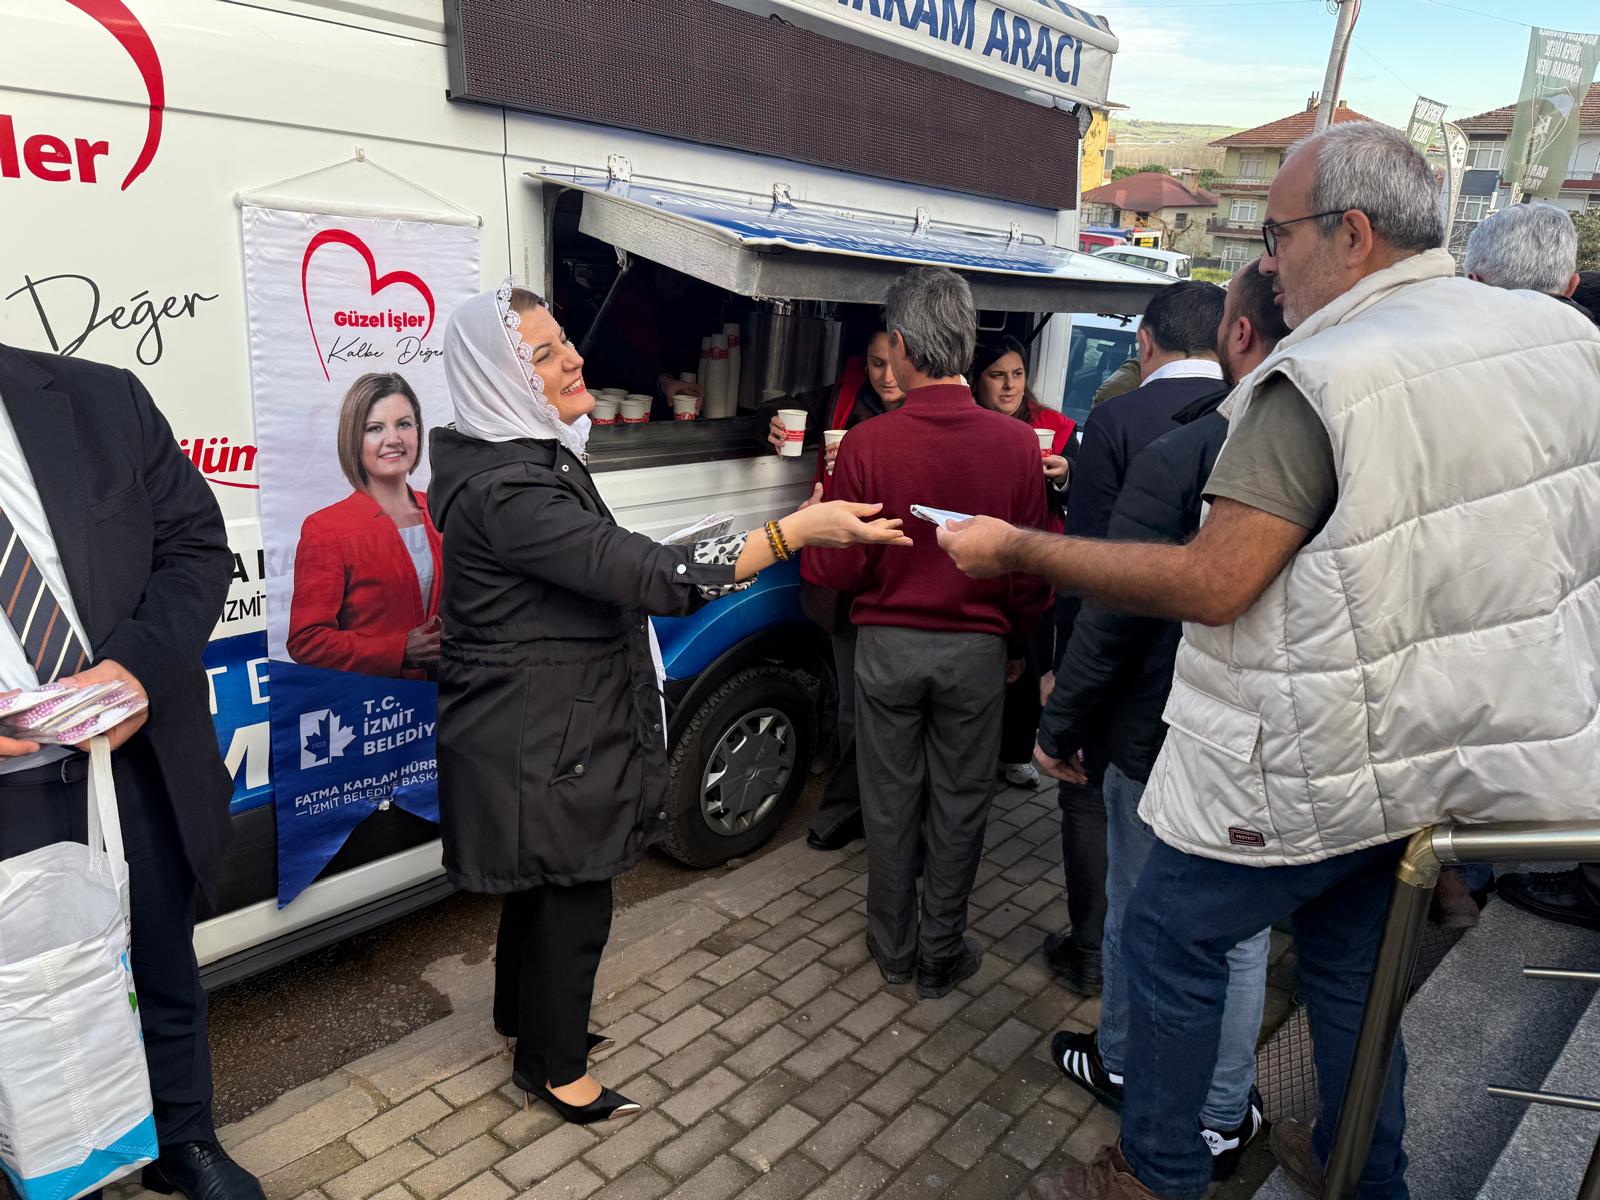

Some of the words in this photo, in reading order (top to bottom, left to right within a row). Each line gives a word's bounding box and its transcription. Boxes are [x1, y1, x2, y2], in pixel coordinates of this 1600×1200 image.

[982, 9, 1081, 86] ARACI
[4, 274, 219, 366] Değer
[334, 310, 385, 328] Güzel
[388, 309, 425, 333] İşler
[327, 336, 384, 364] Kalbe
[363, 695, 401, 715] T.C.
[363, 708, 415, 736] İZMİT
[363, 722, 436, 756] BELEDİY
[295, 785, 340, 808] FATMA
[343, 770, 398, 792] KAPLAN
[400, 759, 438, 776] HÜRR
[309, 797, 340, 815] İZMİT
[343, 780, 399, 805] BELEDİYE
